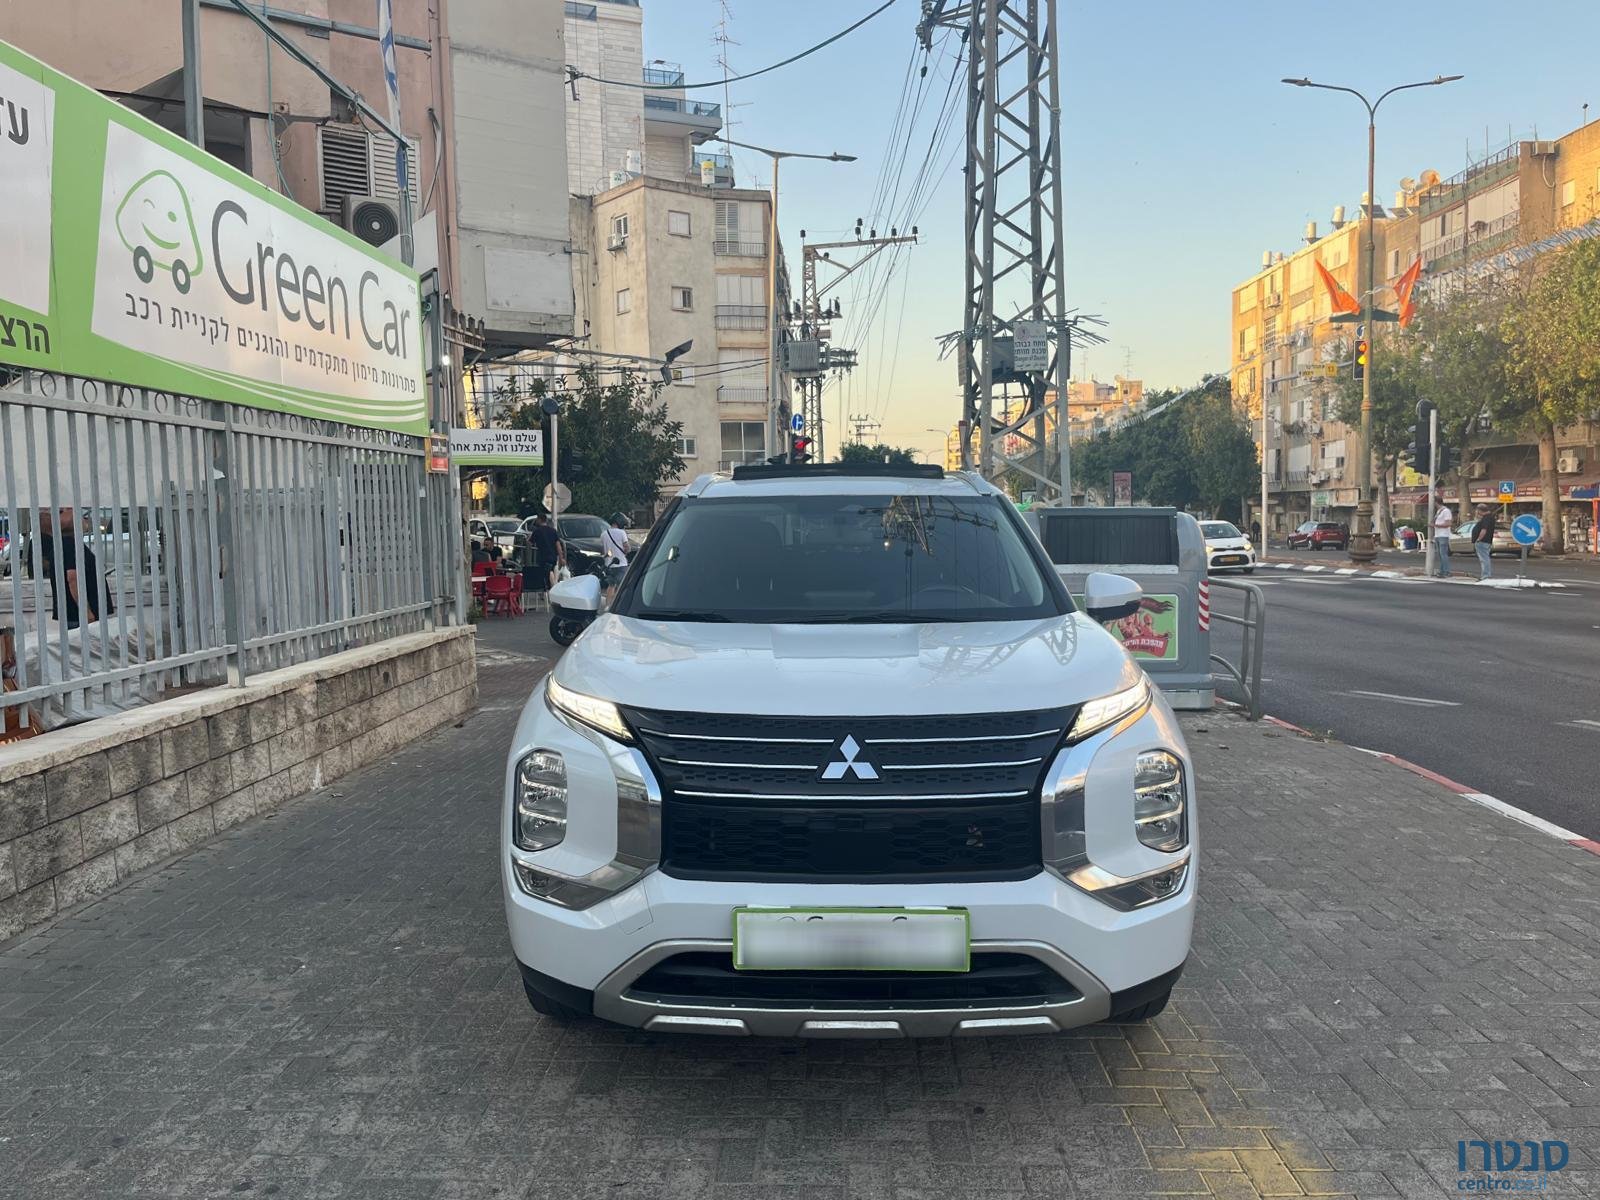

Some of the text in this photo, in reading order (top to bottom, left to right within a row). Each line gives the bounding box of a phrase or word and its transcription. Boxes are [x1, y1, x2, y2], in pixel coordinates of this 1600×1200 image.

[212, 200, 410, 359] Green Car
[125, 293, 416, 394] פתרונות מימון מתקדמים והוגנים לקניית רכב
[515, 433, 537, 442] שלם
[473, 443, 494, 453] קצת
[497, 444, 508, 452] זה
[510, 443, 537, 452] אצלנו
